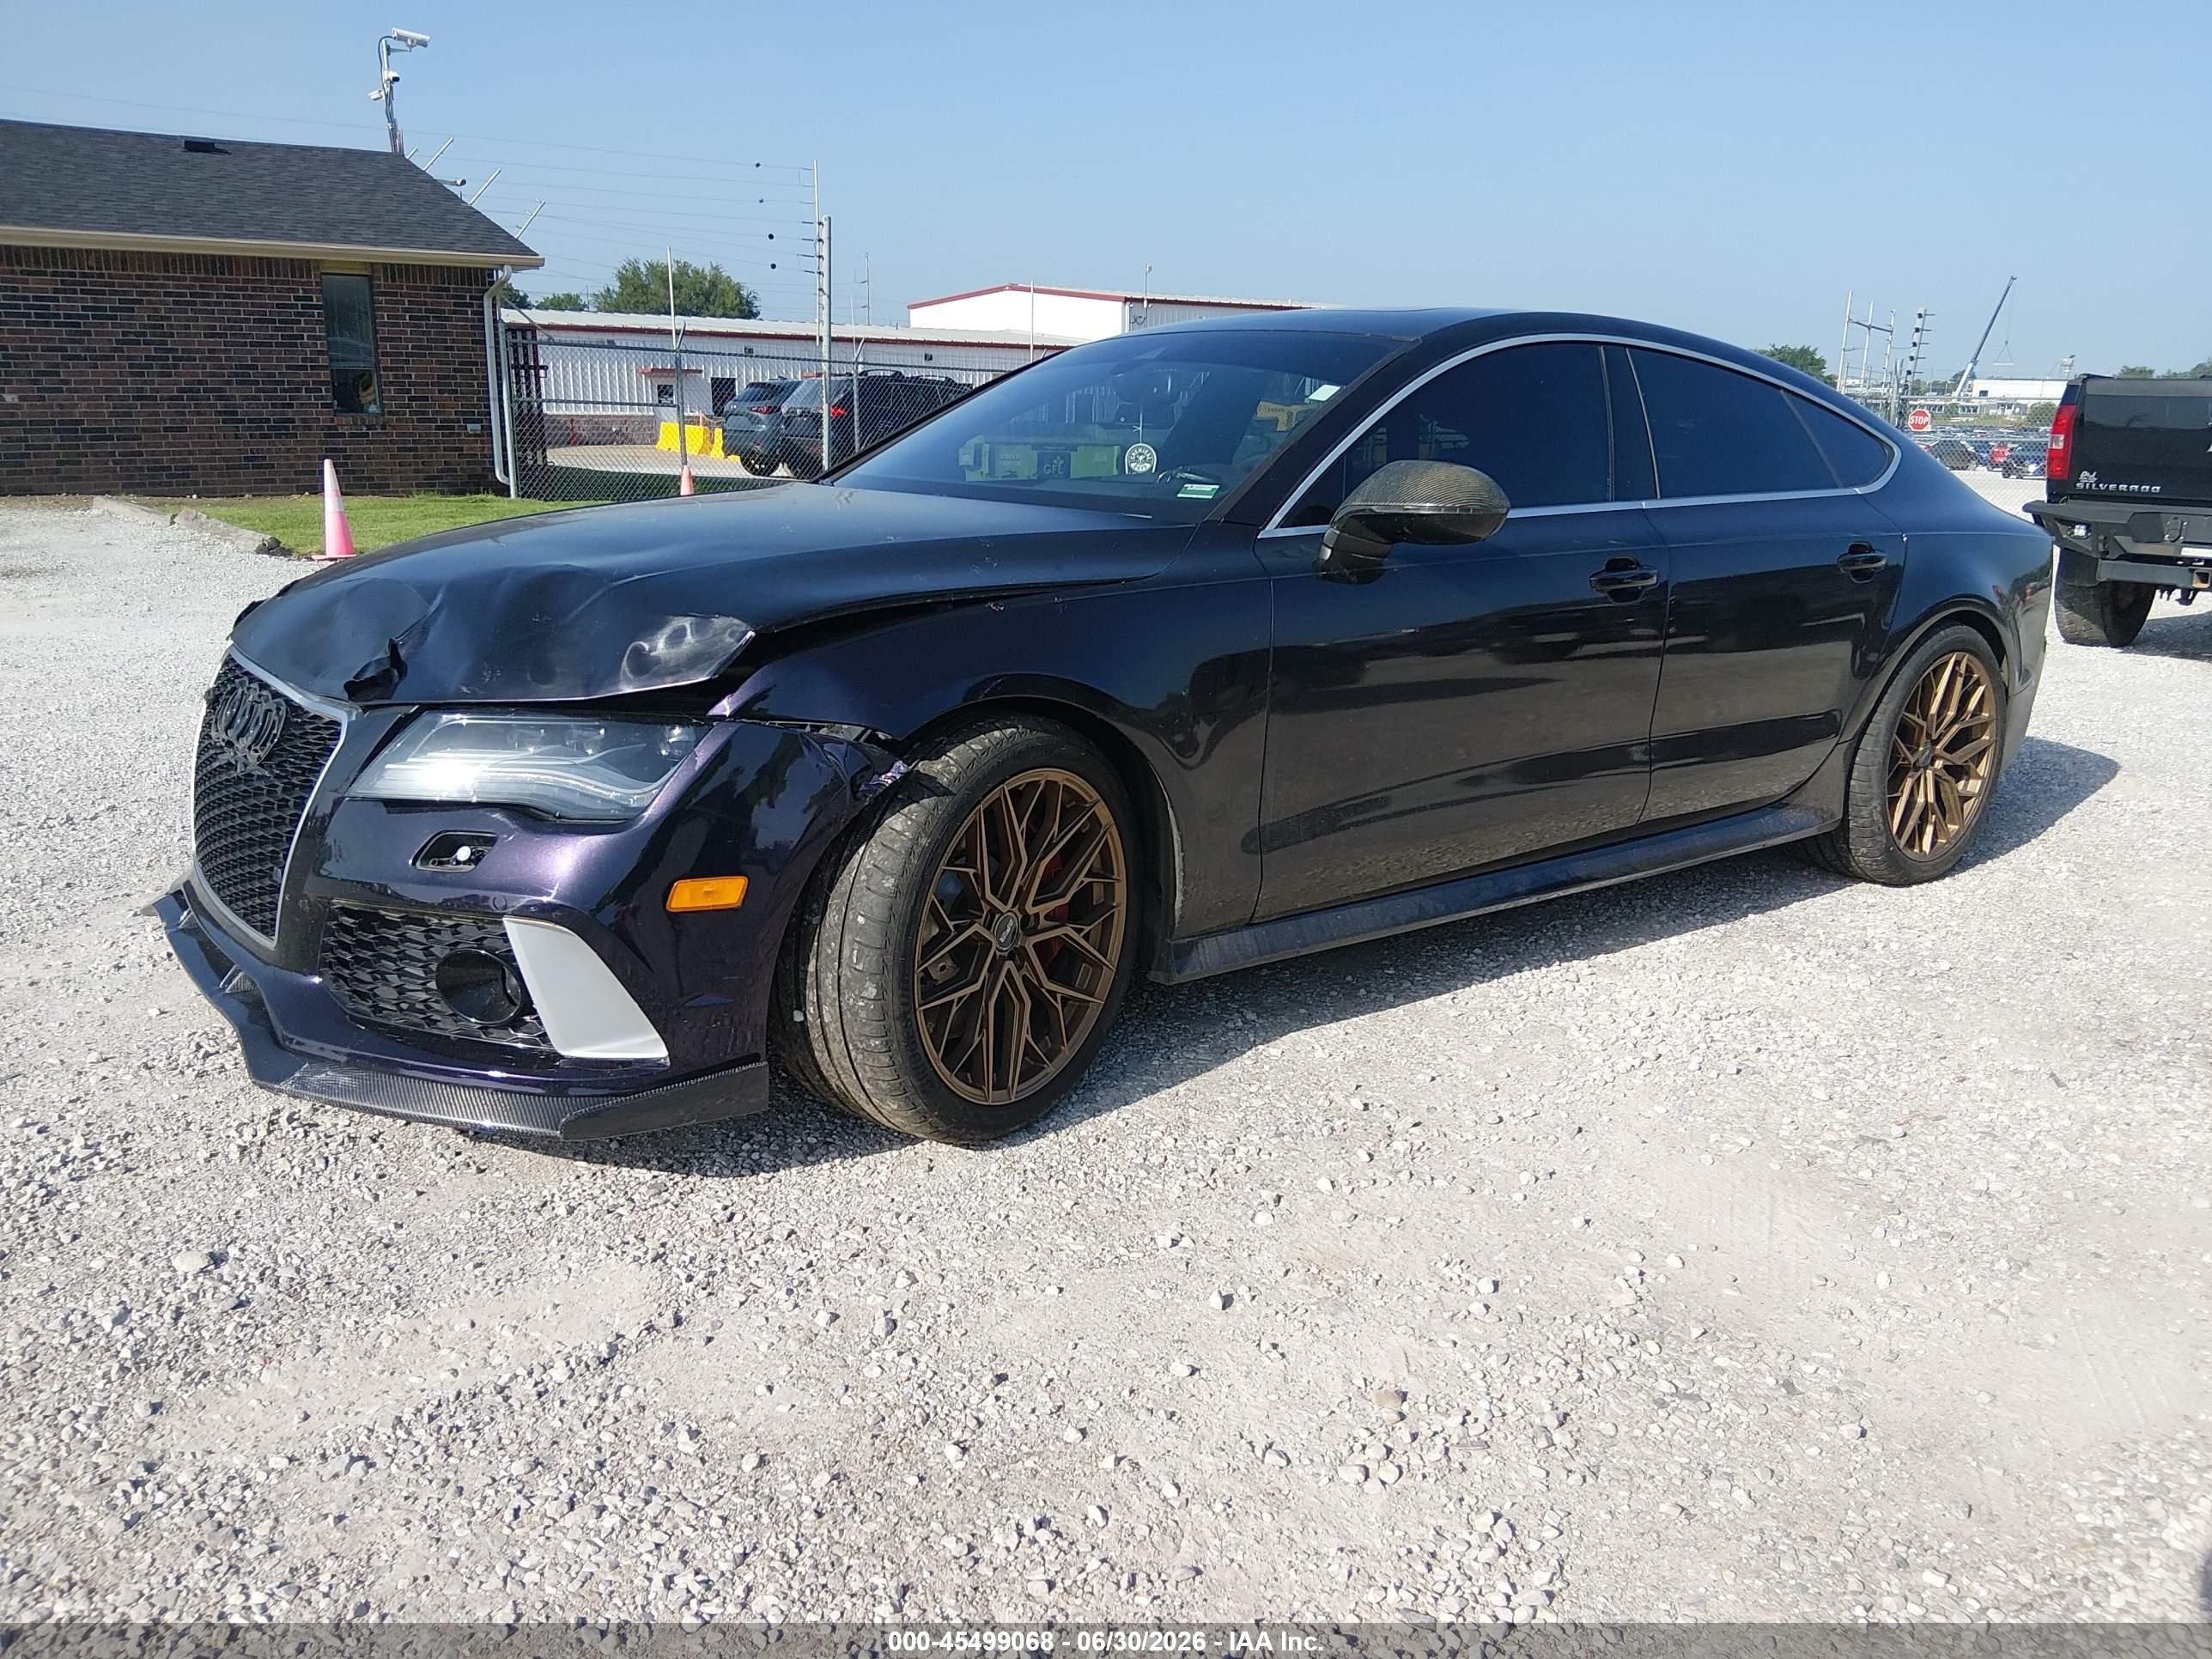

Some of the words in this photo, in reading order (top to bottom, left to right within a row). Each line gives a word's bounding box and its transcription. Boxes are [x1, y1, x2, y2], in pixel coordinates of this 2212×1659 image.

[1910, 416, 1929, 425] STOP
[1043, 459, 1065, 475] GFL
[2075, 483, 2162, 493] SILVERADO
